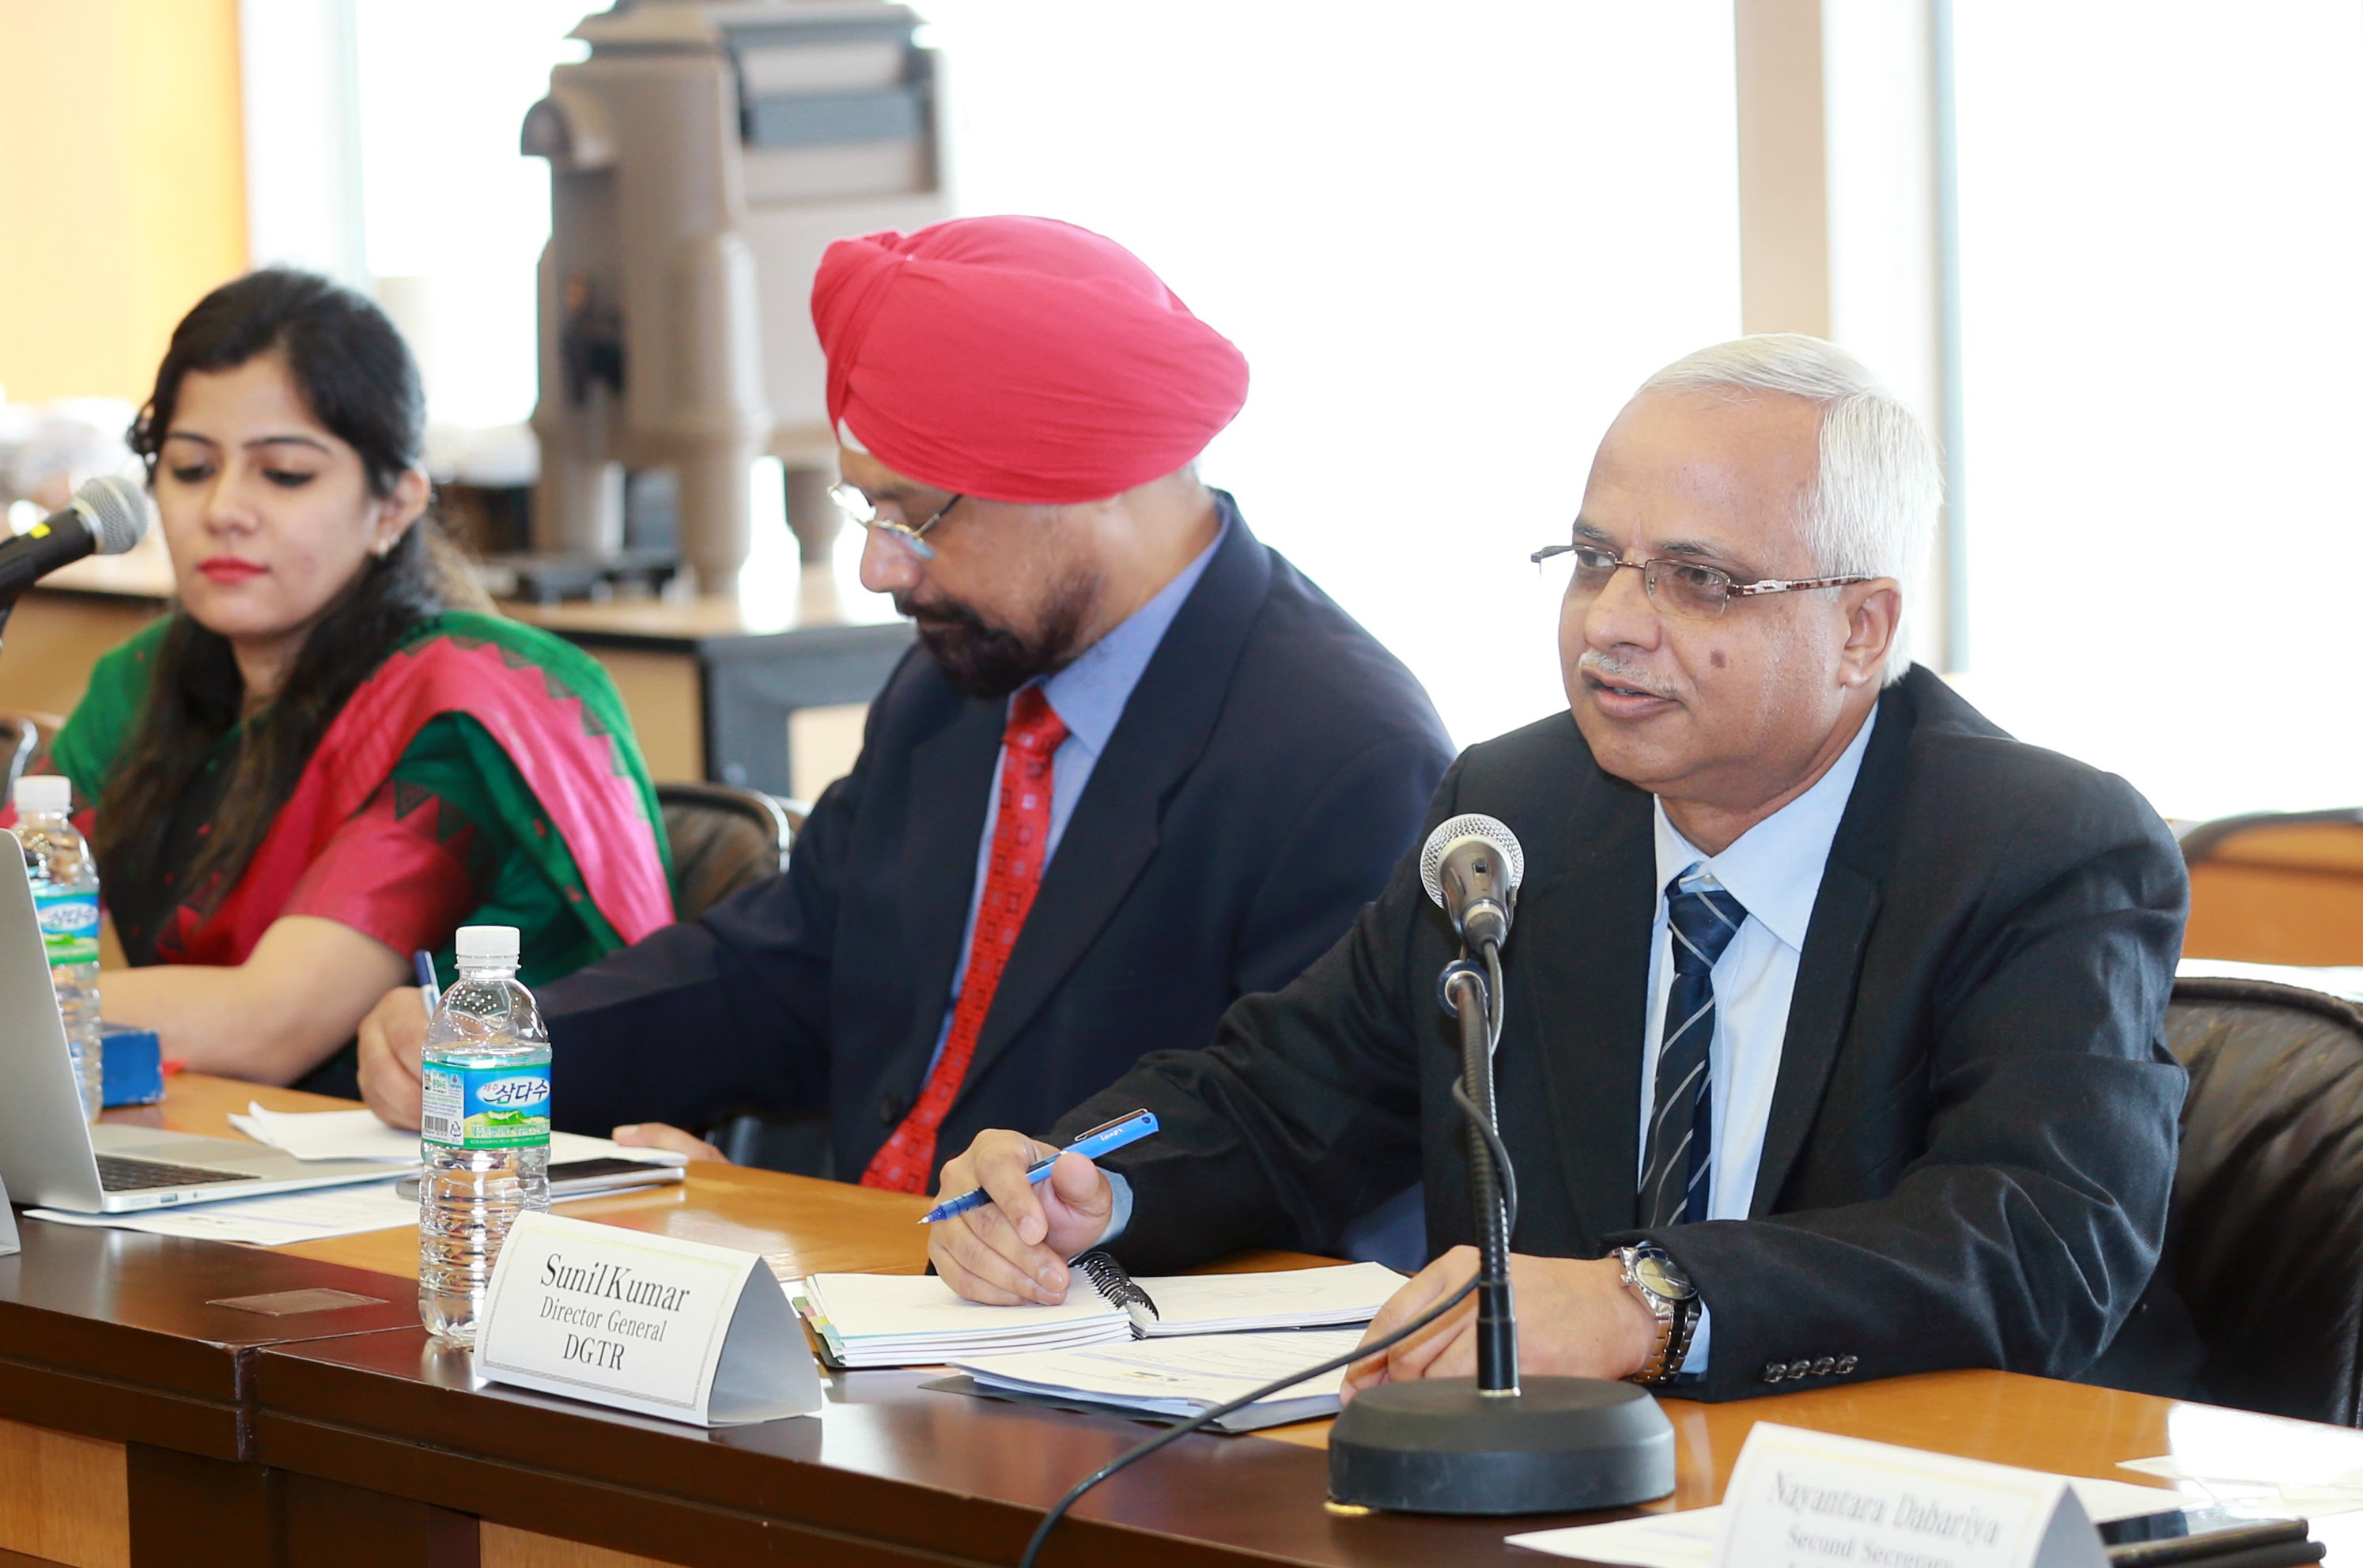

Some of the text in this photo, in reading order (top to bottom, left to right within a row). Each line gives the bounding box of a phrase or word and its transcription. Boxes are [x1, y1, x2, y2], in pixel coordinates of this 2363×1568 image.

[482, 1082, 499, 1092] 제주
[493, 1079, 548, 1105] 삼다수
[539, 1294, 668, 1343] Director General
[561, 1332, 626, 1371] DGTR
[1767, 1469, 1886, 1523] Nayantara
[1786, 1522, 1857, 1559] Second
